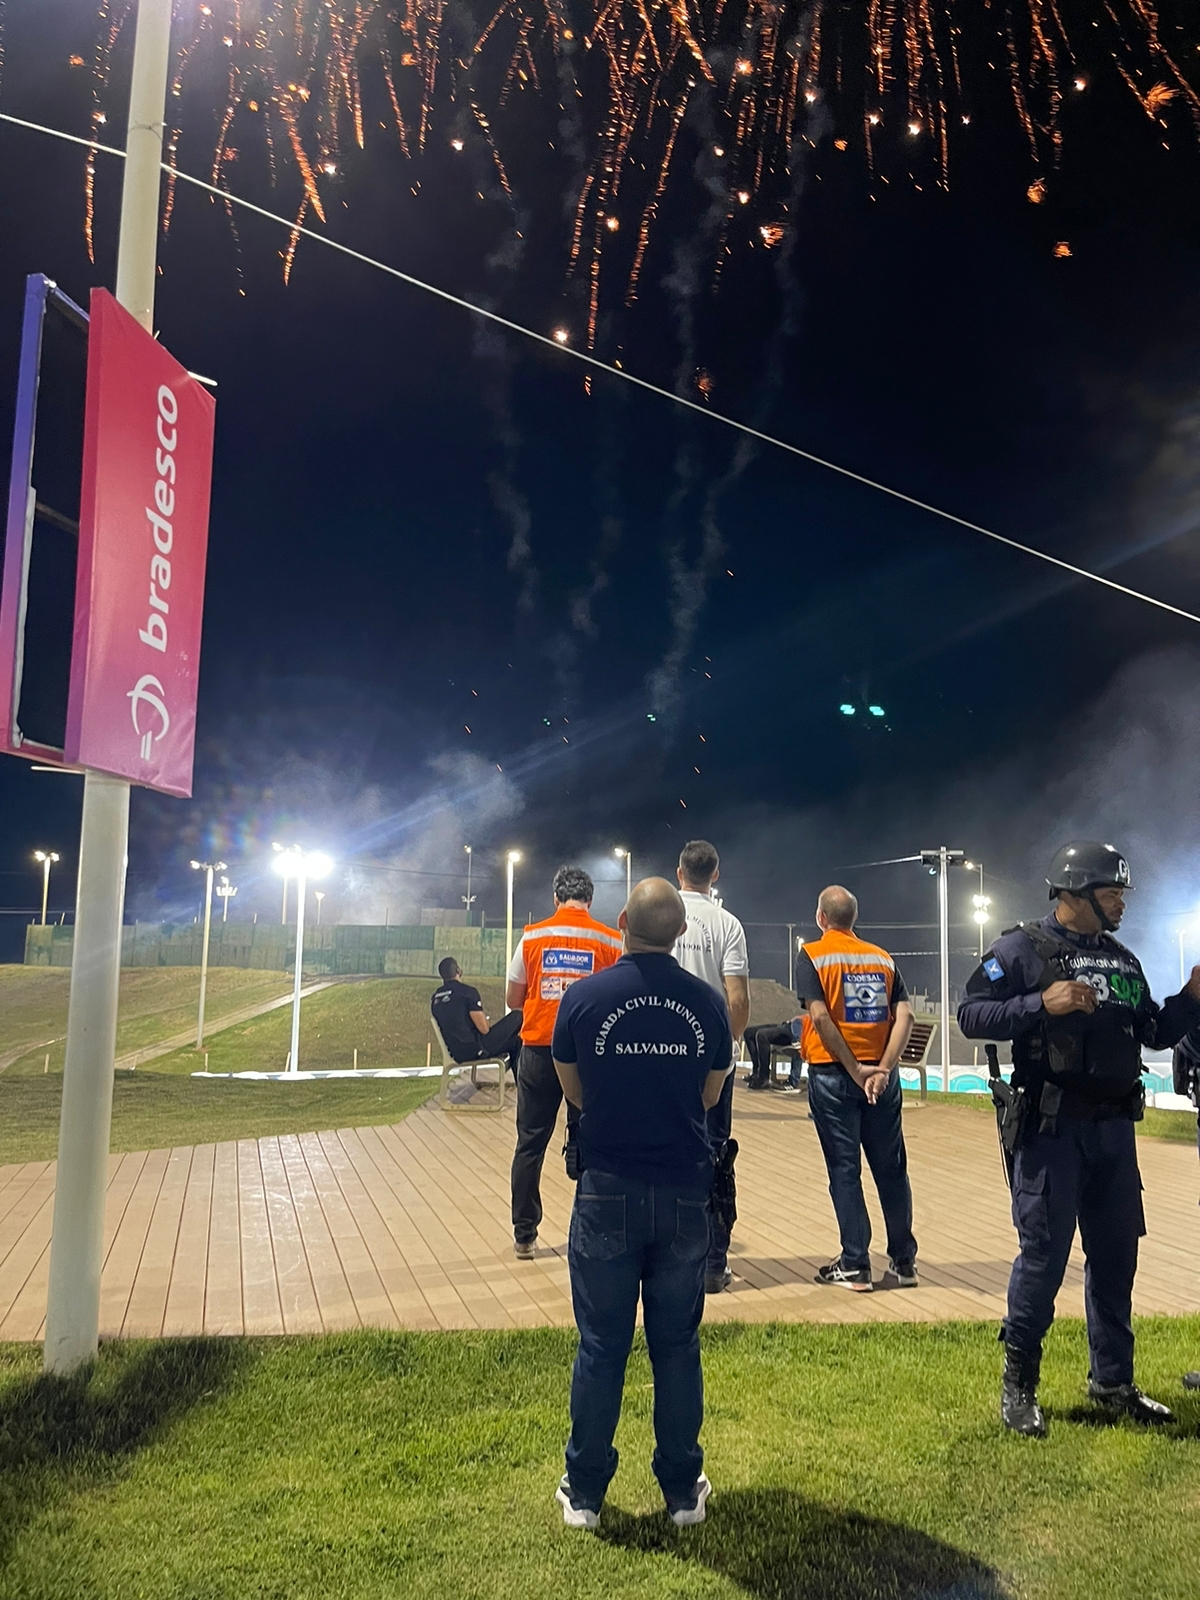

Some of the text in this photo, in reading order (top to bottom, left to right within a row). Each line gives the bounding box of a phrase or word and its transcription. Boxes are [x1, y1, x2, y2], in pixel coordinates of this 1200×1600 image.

[138, 384, 179, 653] bradesco
[559, 953, 589, 963] SALVADOR
[595, 996, 706, 1058] GUARDA CIVIL MUNICIPAL
[615, 1043, 688, 1056] SALVADOR
